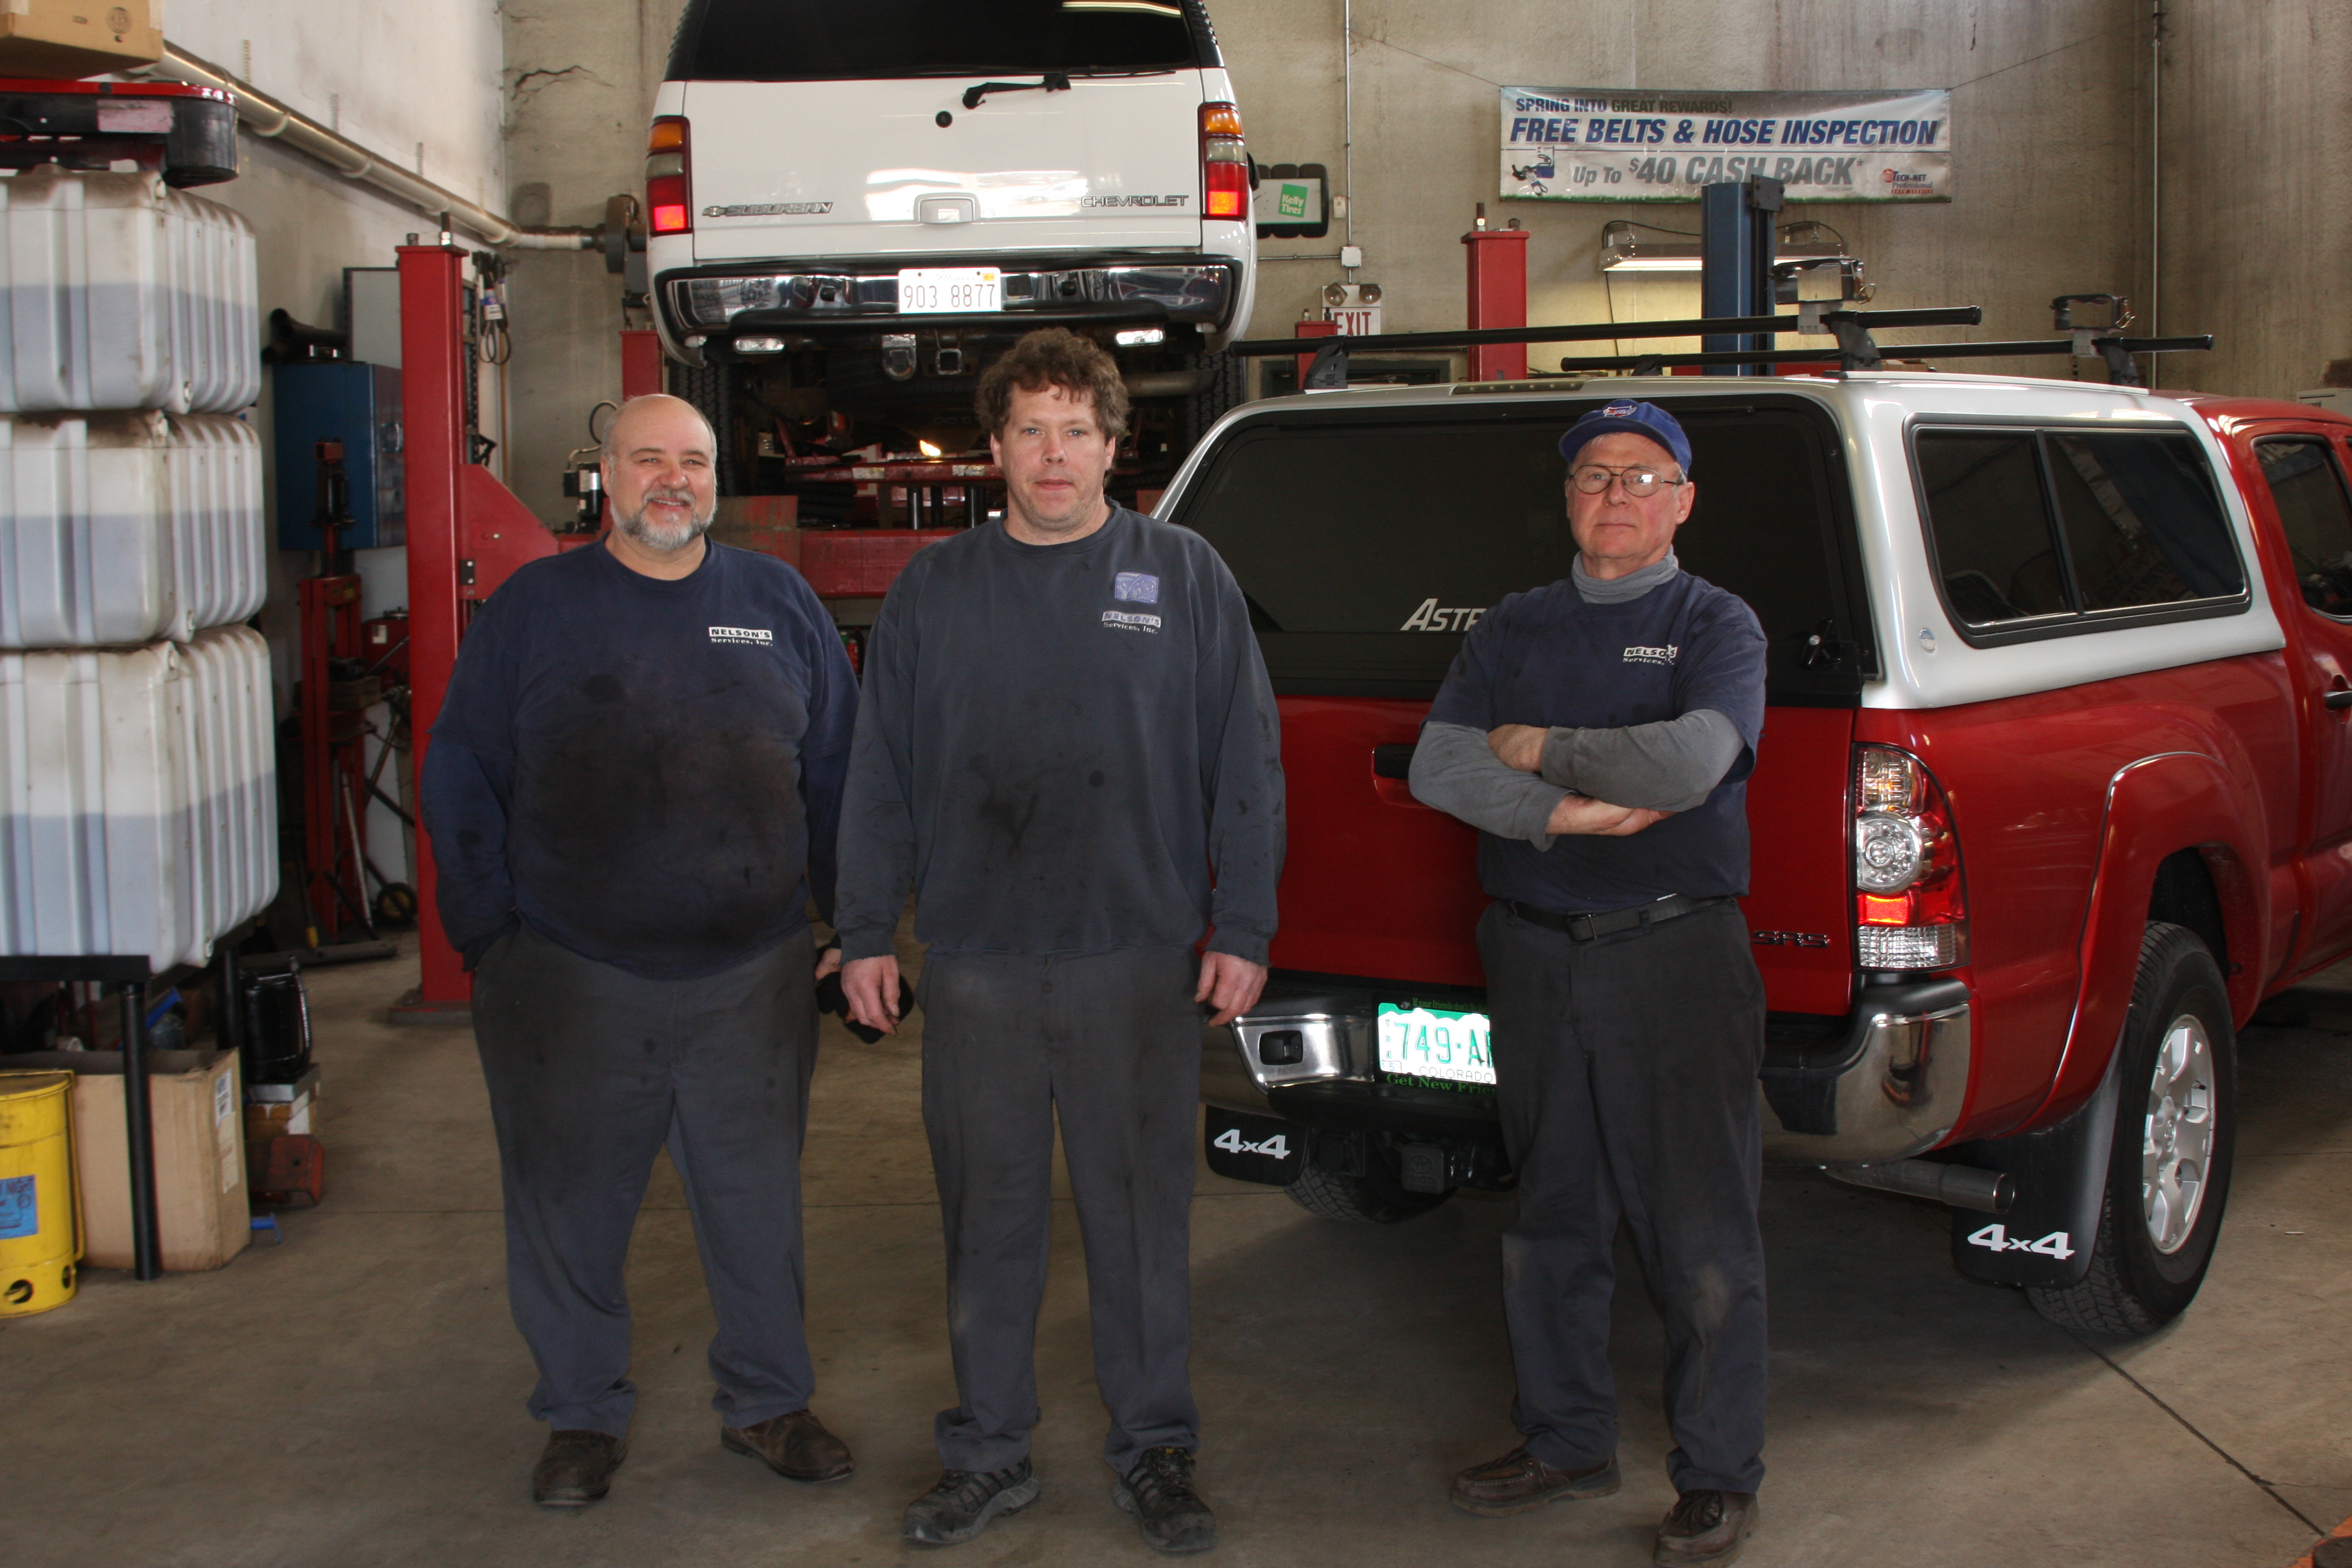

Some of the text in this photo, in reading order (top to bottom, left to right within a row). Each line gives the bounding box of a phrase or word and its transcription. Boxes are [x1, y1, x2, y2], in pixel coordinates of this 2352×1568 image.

[1515, 98, 1733, 114] SPRING INTO GREAT REWARDS!
[1510, 117, 1936, 145] FREE BELTS & HOSE INSPECTION
[1573, 166, 1597, 187] Up
[1603, 166, 1622, 184] To
[1629, 156, 1676, 185] $40
[1685, 156, 1765, 185] CASH
[1081, 195, 1189, 207] CHEVROLET
[1282, 194, 1305, 207] Kelly
[725, 201, 834, 217] SUBURBAN
[1281, 203, 1302, 215] Tires
[904, 284, 995, 309] 903 8877
[1334, 312, 1372, 336] EXIT
[1104, 613, 1160, 626] NELSON'S
[711, 629, 770, 638] NELSON'S
[1103, 622, 1157, 634] Services, Inc.
[1626, 648, 1676, 657] NELSOS
[1387, 1073, 1414, 1086] Get
[1418, 1077, 1452, 1091] New
[1419, 1066, 1493, 1083] COLORADO
[1214, 1128, 1291, 1160] 4x4
[1967, 1223, 2076, 1261] 4x4
